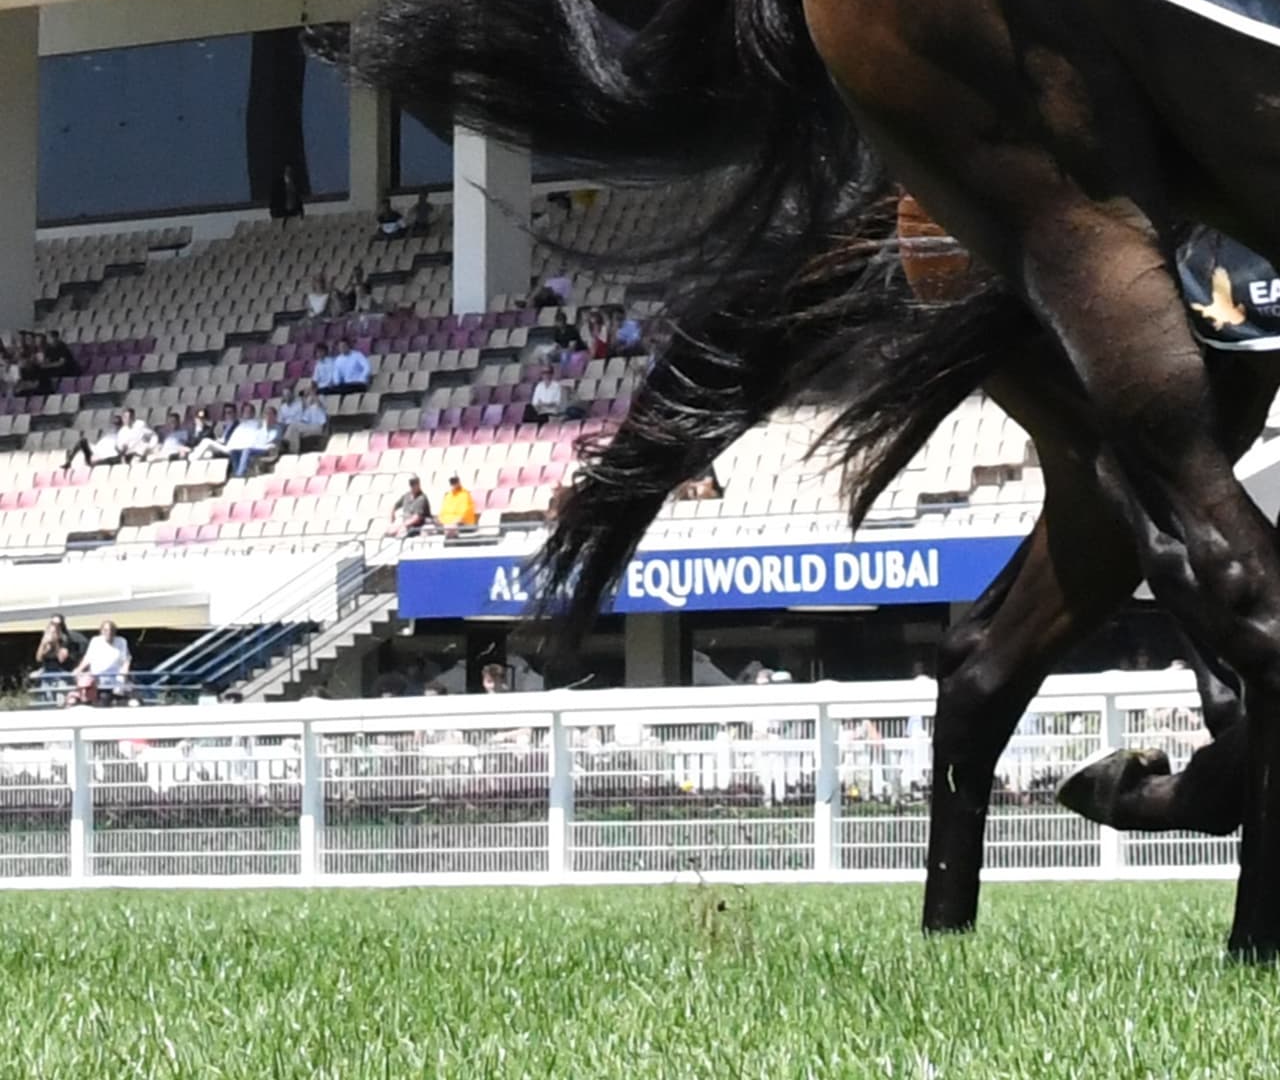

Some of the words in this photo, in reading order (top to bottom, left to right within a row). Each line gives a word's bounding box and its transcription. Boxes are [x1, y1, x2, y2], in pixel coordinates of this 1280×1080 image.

[490, 566, 528, 601] AL
[627, 553, 827, 607] EQUIWORLD
[834, 549, 939, 591] DUBAI
